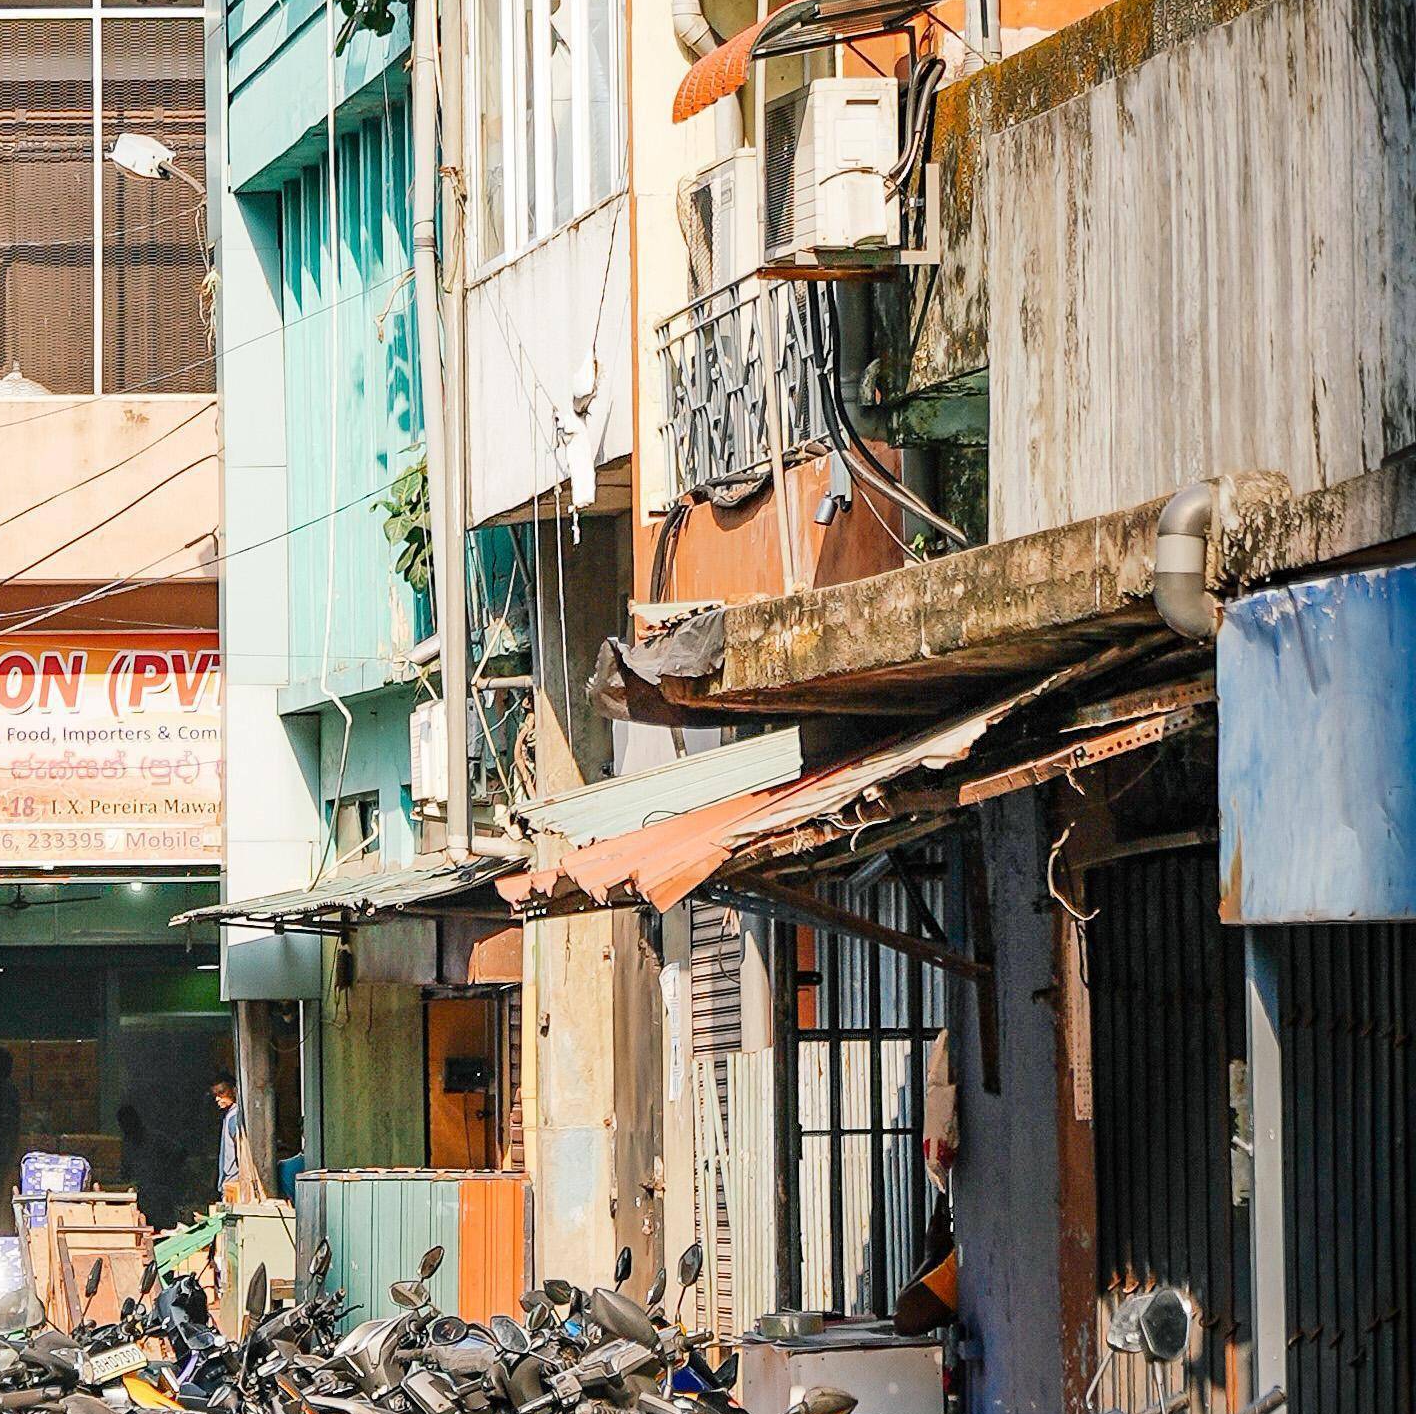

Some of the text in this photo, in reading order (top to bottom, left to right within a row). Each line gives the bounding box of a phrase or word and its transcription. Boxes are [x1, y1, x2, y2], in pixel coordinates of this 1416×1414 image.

[7, 727, 57, 744] Food,
[63, 727, 151, 744] Importers
[157, 726, 171, 740] &
[51, 799, 62, 815] I.
[68, 799, 84, 815] X.
[90, 799, 158, 815] Pereira
[126, 831, 201, 850] Mobile
